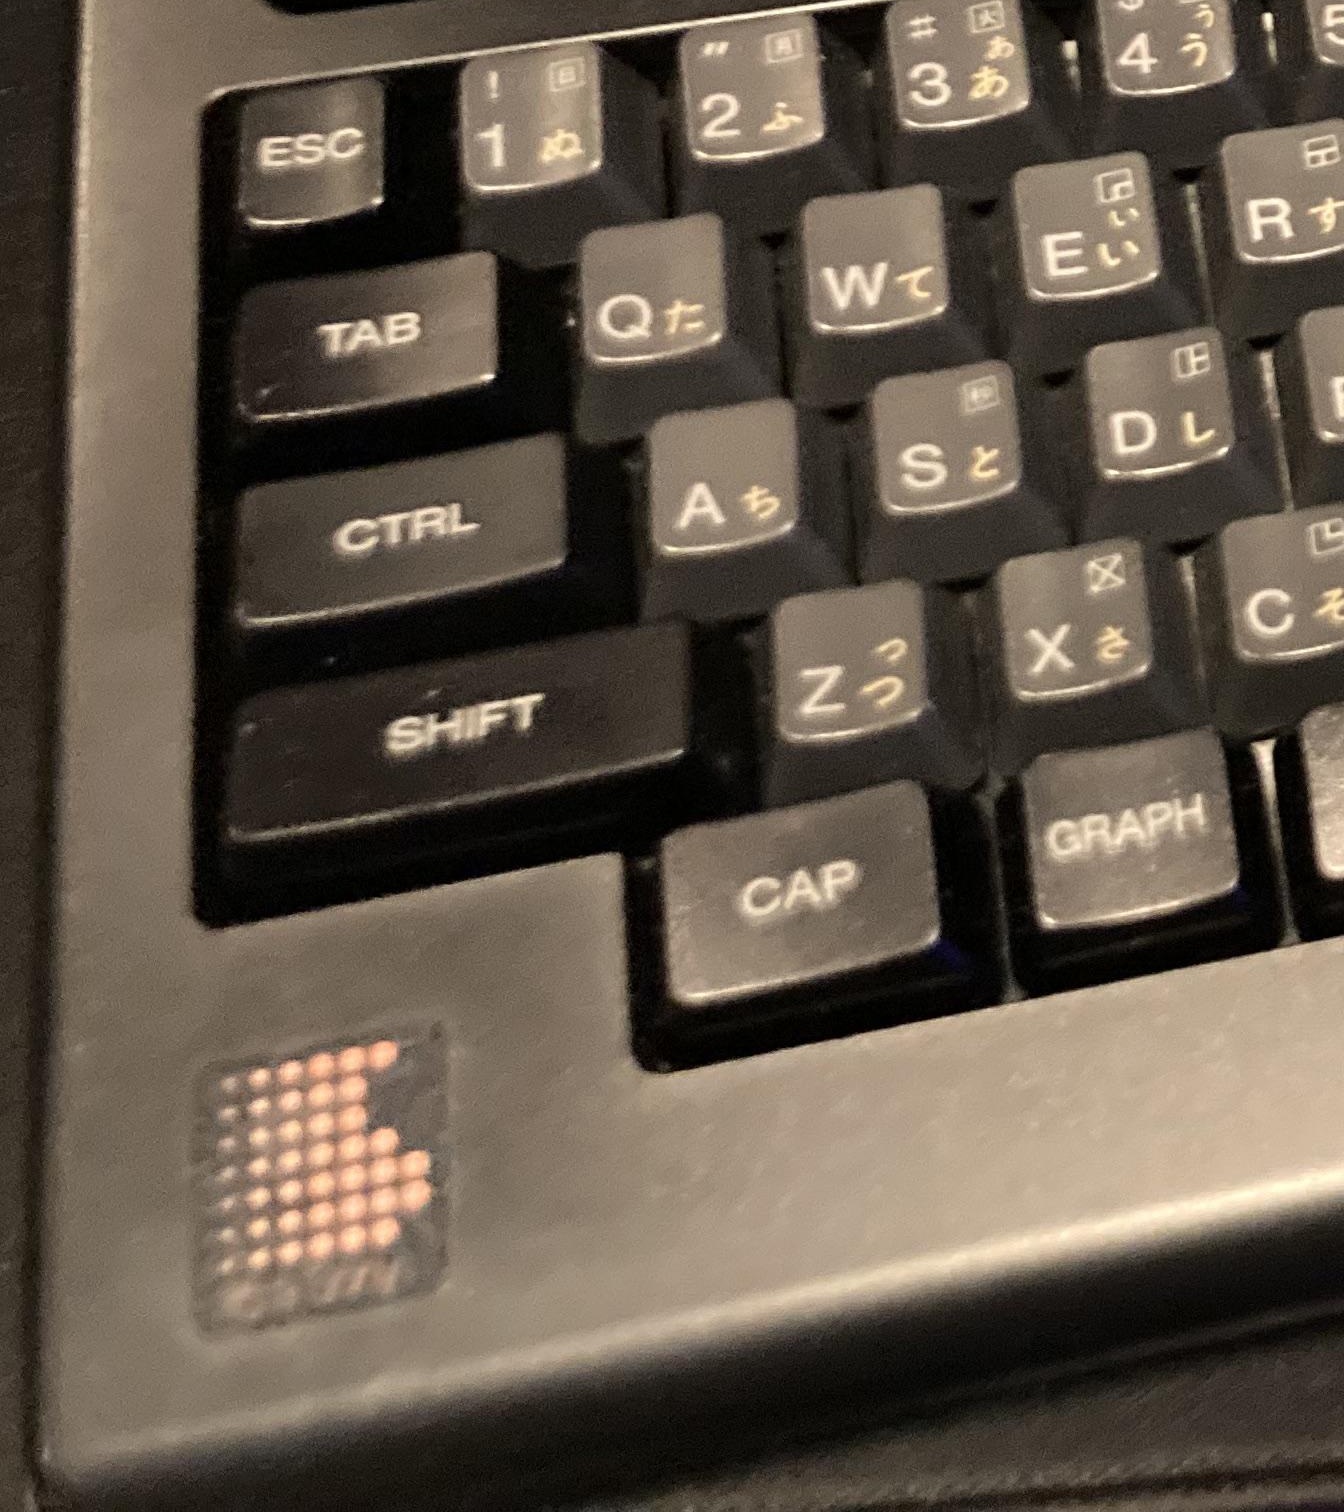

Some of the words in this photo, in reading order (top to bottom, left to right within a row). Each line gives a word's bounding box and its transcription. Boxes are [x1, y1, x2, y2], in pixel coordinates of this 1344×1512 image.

[1117, 33, 1158, 74] 4
[909, 63, 951, 106] 3
[702, 93, 740, 138] 2
[256, 129, 364, 169] ESC
[478, 124, 504, 168] 1
[1247, 198, 1293, 241] R
[1043, 232, 1088, 277] E
[822, 262, 888, 310] W
[319, 312, 422, 357] TAB
[598, 295, 652, 341] Q
[1110, 411, 1156, 456] D
[901, 444, 947, 490] S
[333, 502, 479, 556] CTRL
[677, 483, 725, 529] A
[1245, 589, 1294, 638] C
[1026, 625, 1074, 675] X
[800, 666, 845, 717] Z
[383, 693, 545, 760] SHIFT
[1047, 793, 1206, 863] GRAPH
[739, 860, 861, 922] CAP
